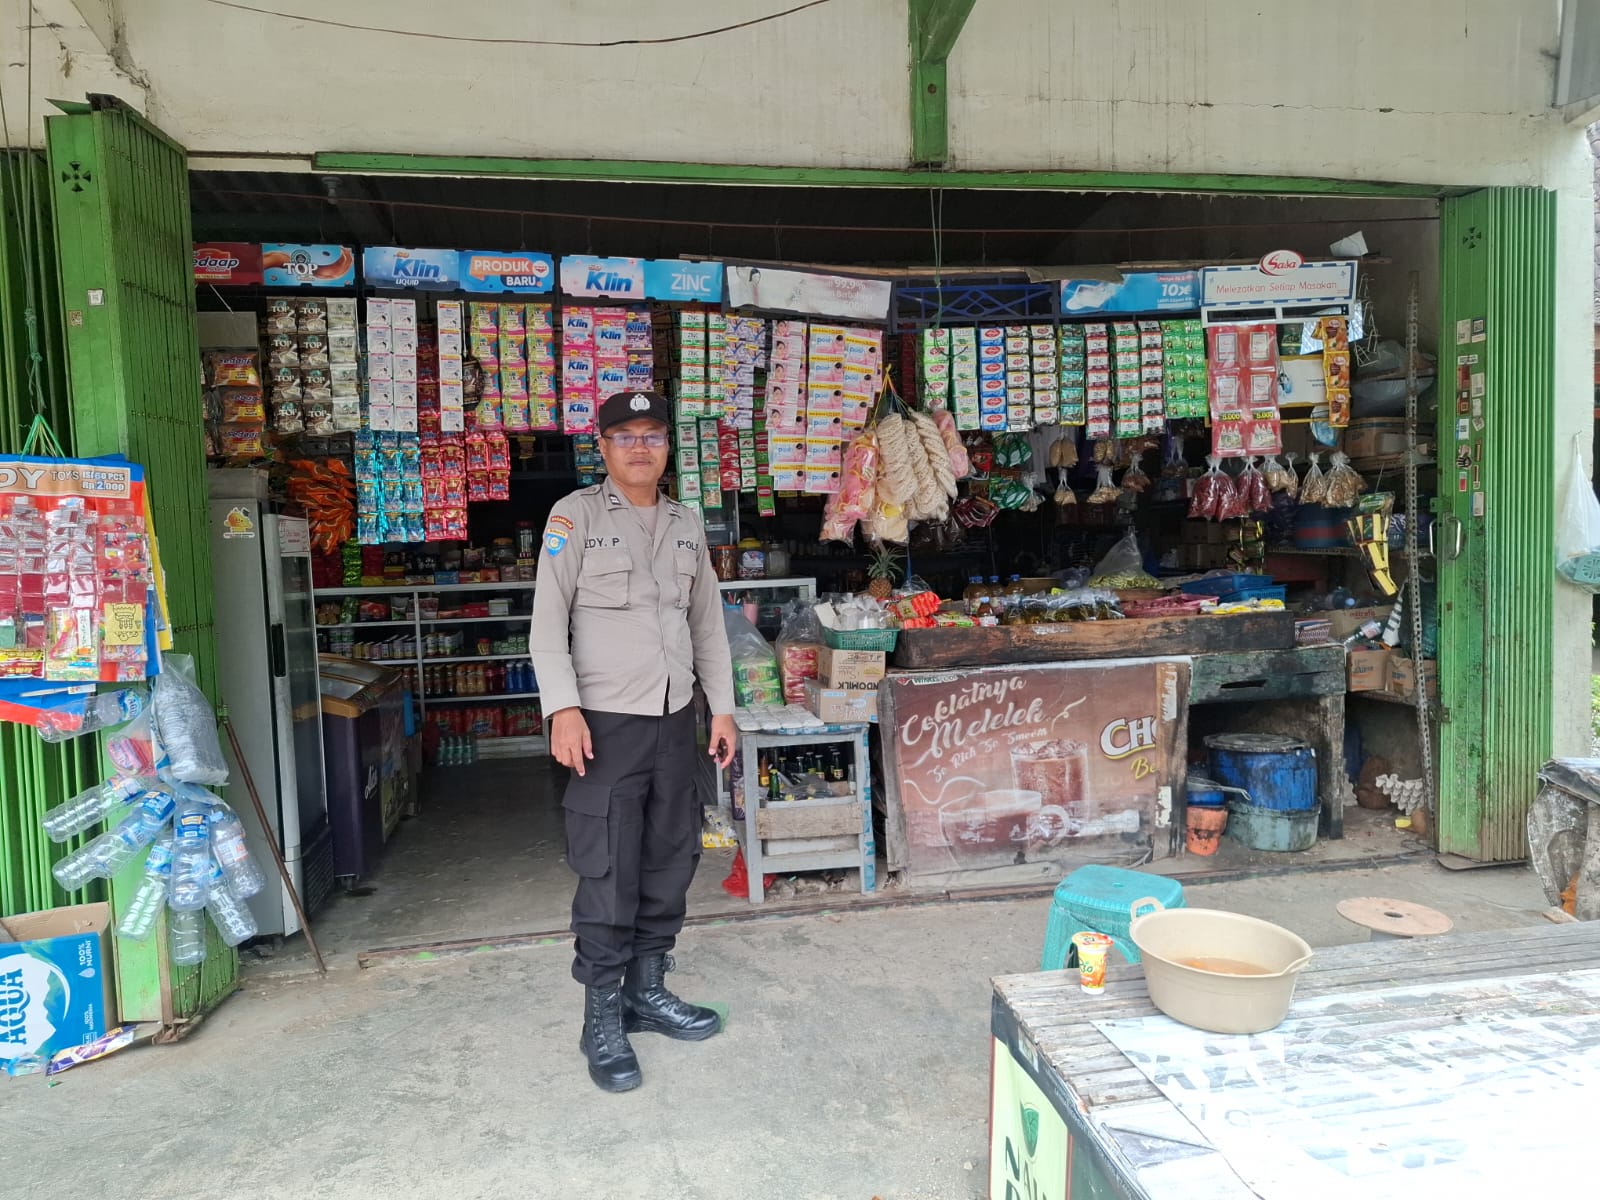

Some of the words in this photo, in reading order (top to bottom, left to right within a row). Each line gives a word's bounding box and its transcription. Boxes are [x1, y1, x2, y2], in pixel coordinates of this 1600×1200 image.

[283, 262, 319, 275] TOP
[393, 257, 440, 279] Klin
[474, 260, 530, 273] PRODUK
[506, 276, 536, 287] BARU
[586, 271, 632, 292] Klin
[671, 271, 711, 292] ZINC
[1217, 284, 1265, 295] Melezatkan
[1269, 282, 1296, 293] Setiap
[1299, 280, 1337, 291] Masakan
[567, 317, 588, 328] Klin
[600, 331, 621, 341] Klin
[568, 361, 588, 371] Klin
[602, 373, 623, 382] Klin
[569, 404, 589, 414] Klin
[52, 471, 80, 480] TOYS
[107, 473, 124, 482] PCS
[1100, 715, 1157, 758] CH
[951, 746, 977, 769] Rich
[78, 943, 86, 966] 100%
[85, 940, 93, 967] MURNI
[0, 968, 31, 1045] AQUA
